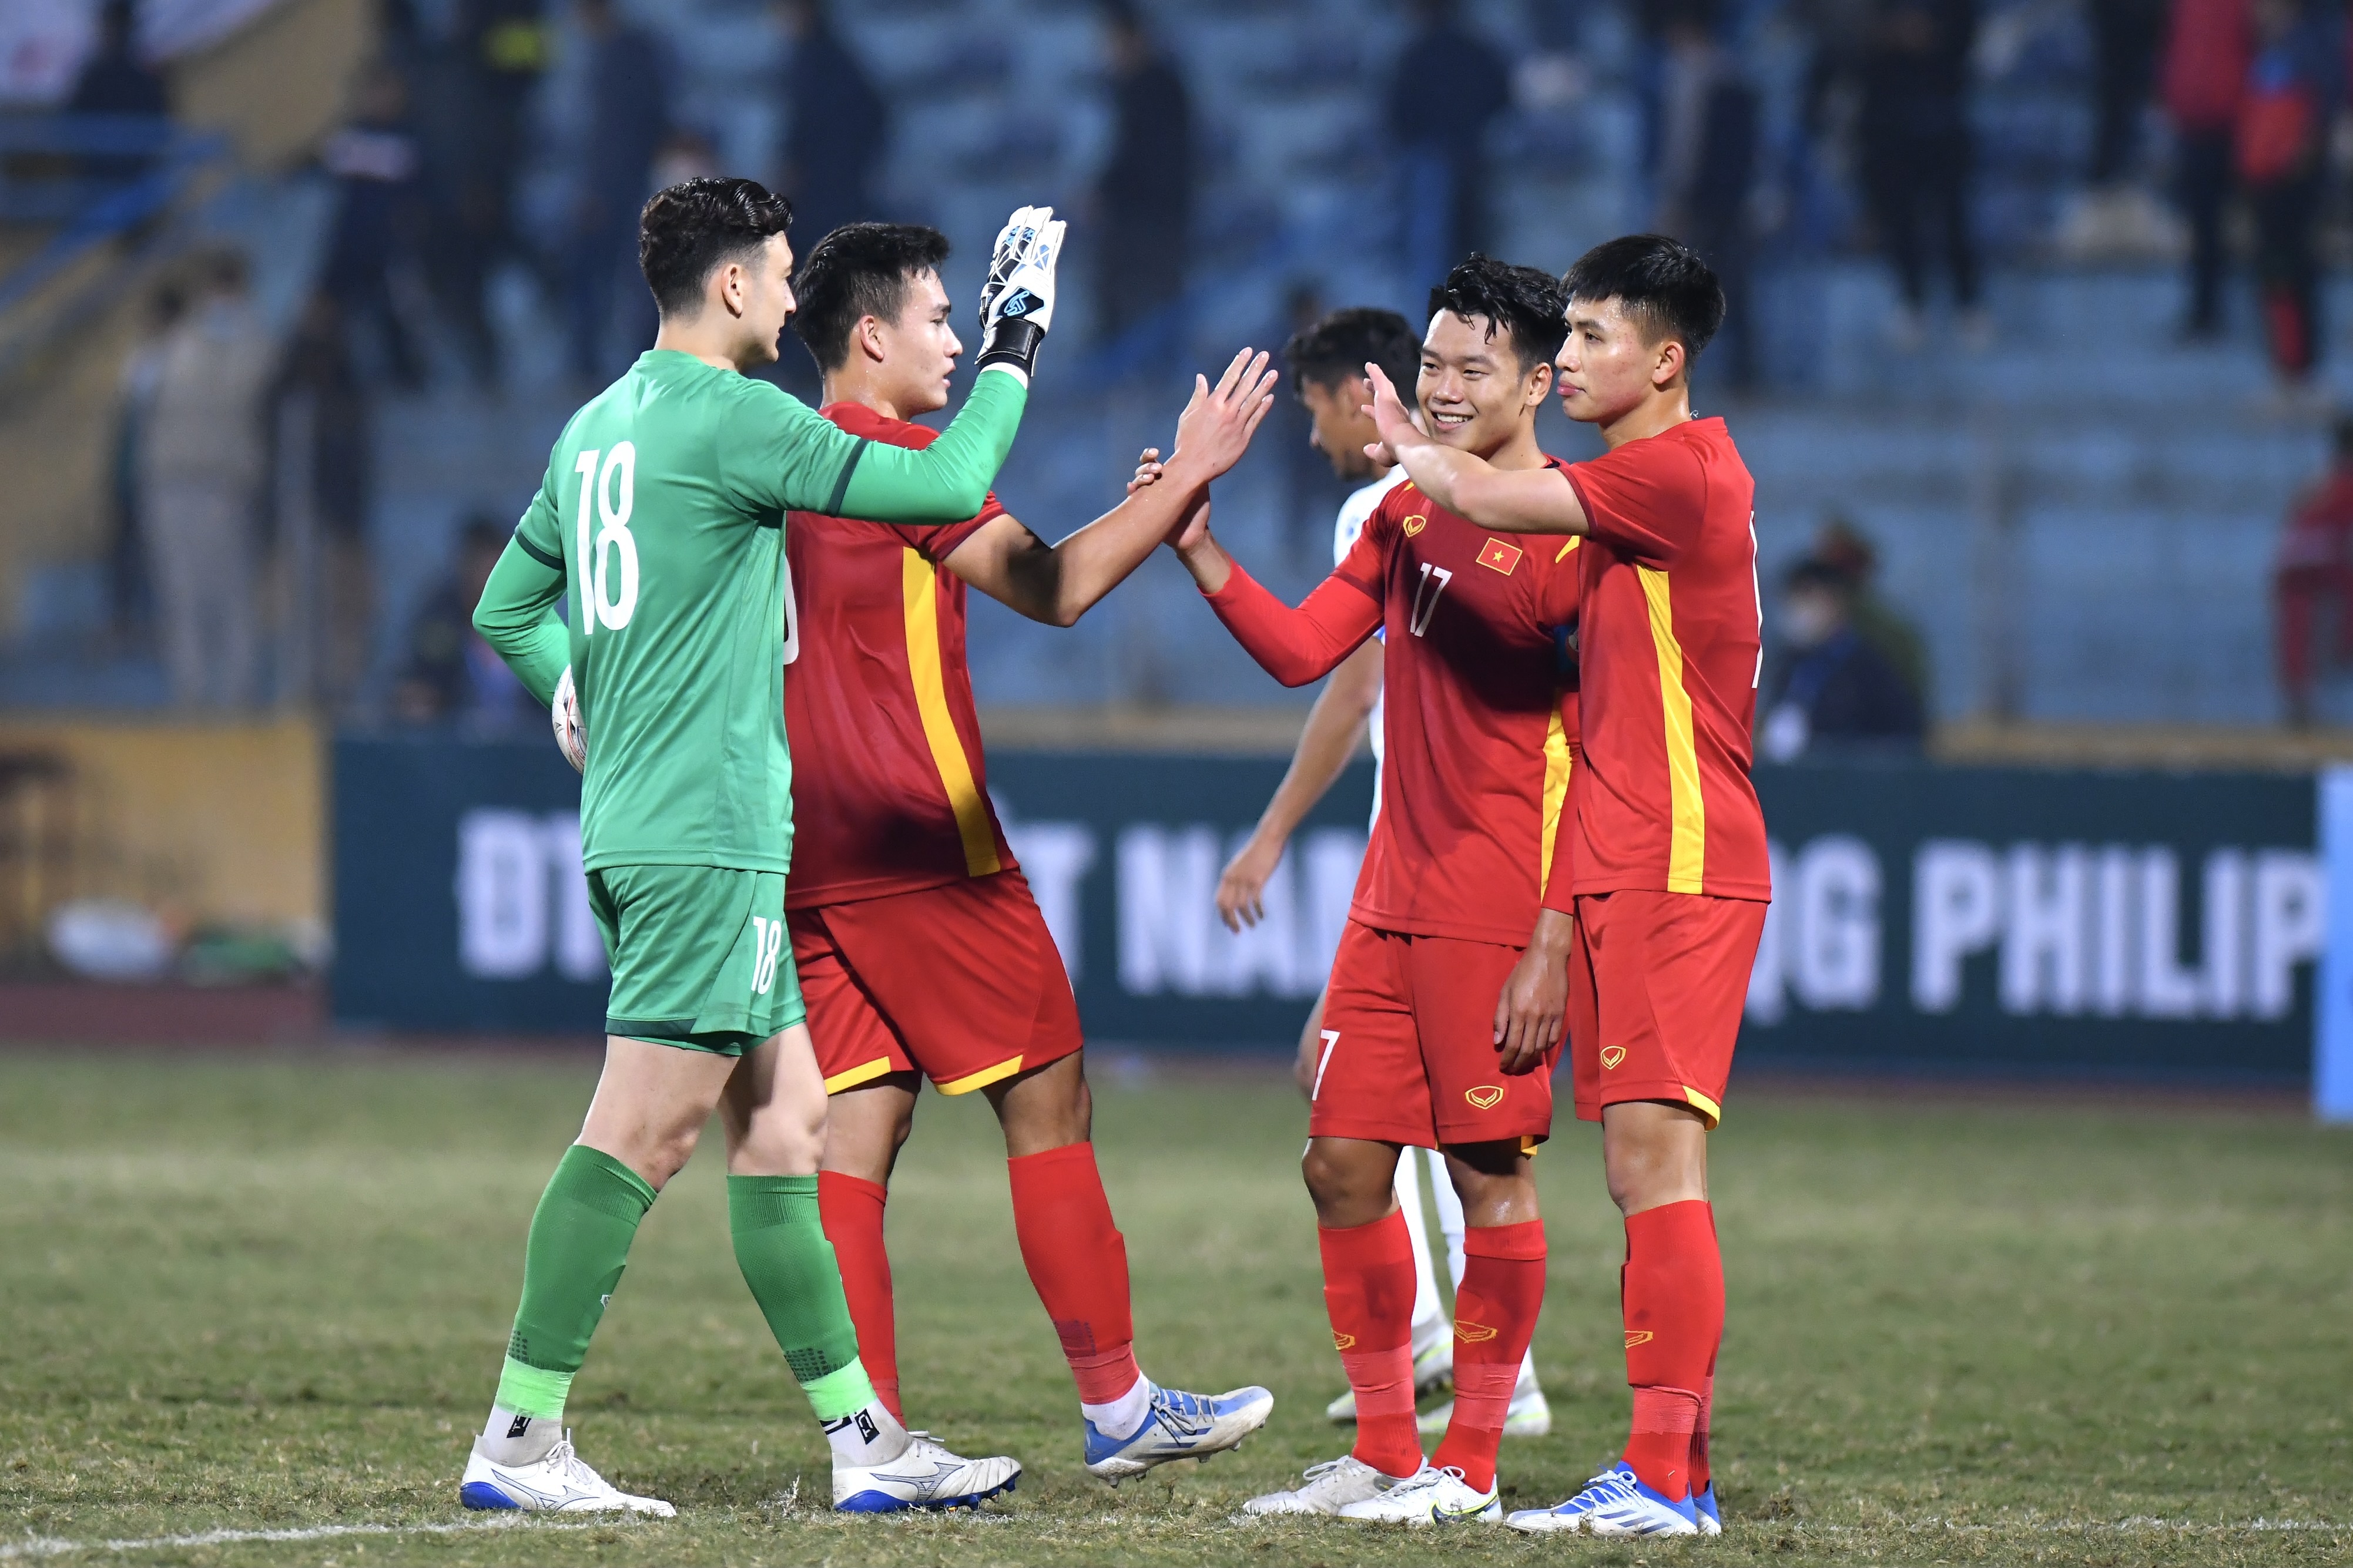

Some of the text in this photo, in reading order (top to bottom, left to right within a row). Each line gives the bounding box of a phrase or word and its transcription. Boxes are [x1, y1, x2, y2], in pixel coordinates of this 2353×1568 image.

[574, 440, 639, 636] 18
[1410, 562, 1453, 637] 17
[750, 916, 782, 995] 18
